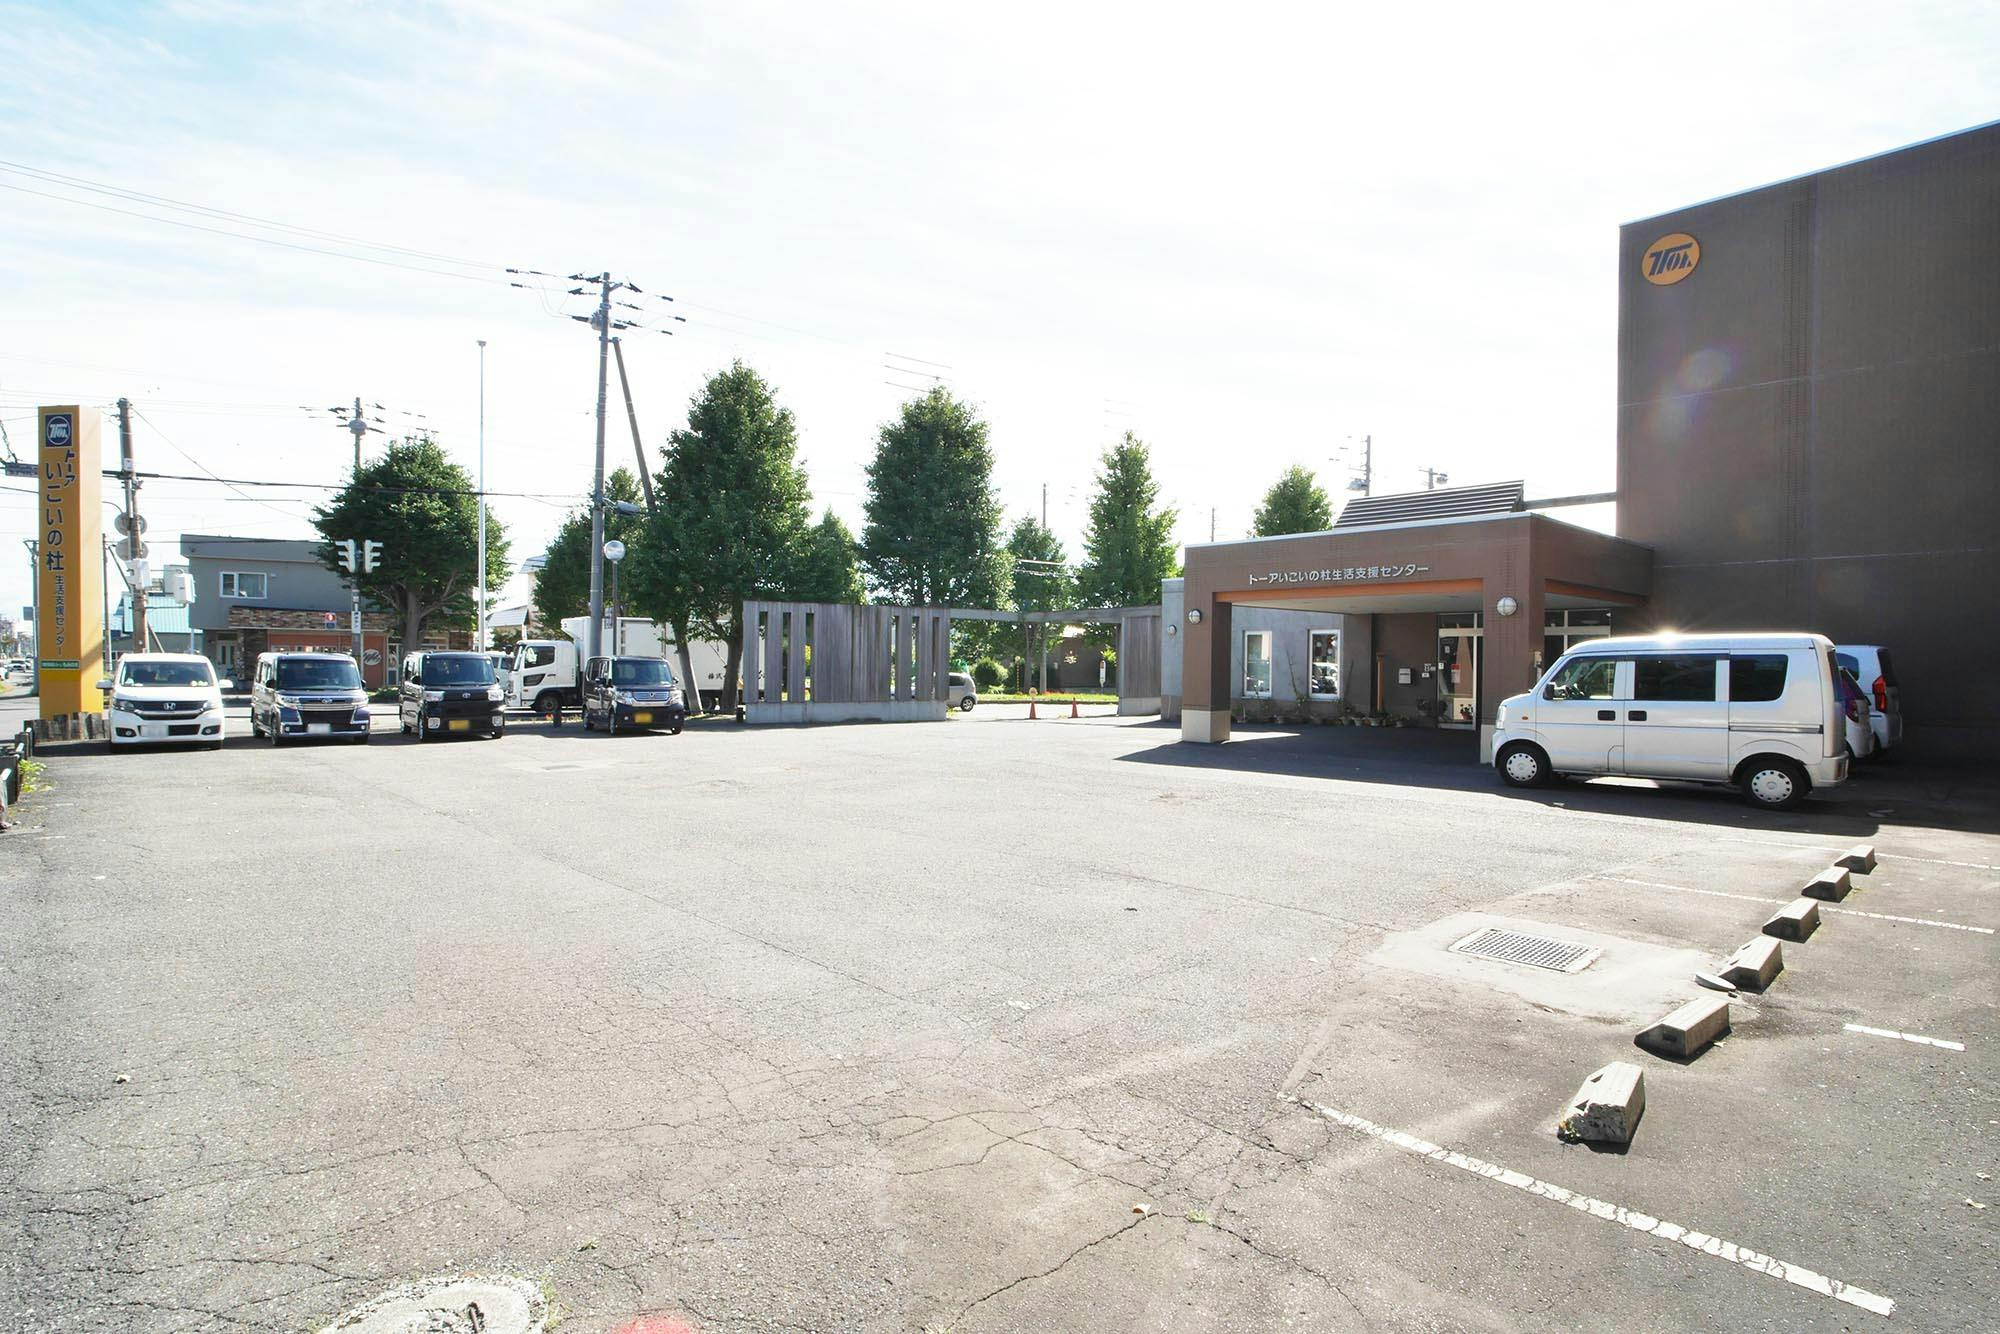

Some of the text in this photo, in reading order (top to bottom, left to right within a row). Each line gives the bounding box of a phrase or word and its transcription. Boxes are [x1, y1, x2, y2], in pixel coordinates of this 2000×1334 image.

[64, 450, 75, 487] トーア
[46, 463, 65, 656] いこいの杜 生活支援センター
[1249, 564, 1429, 585] トーアいこいの杜生活支援センター
